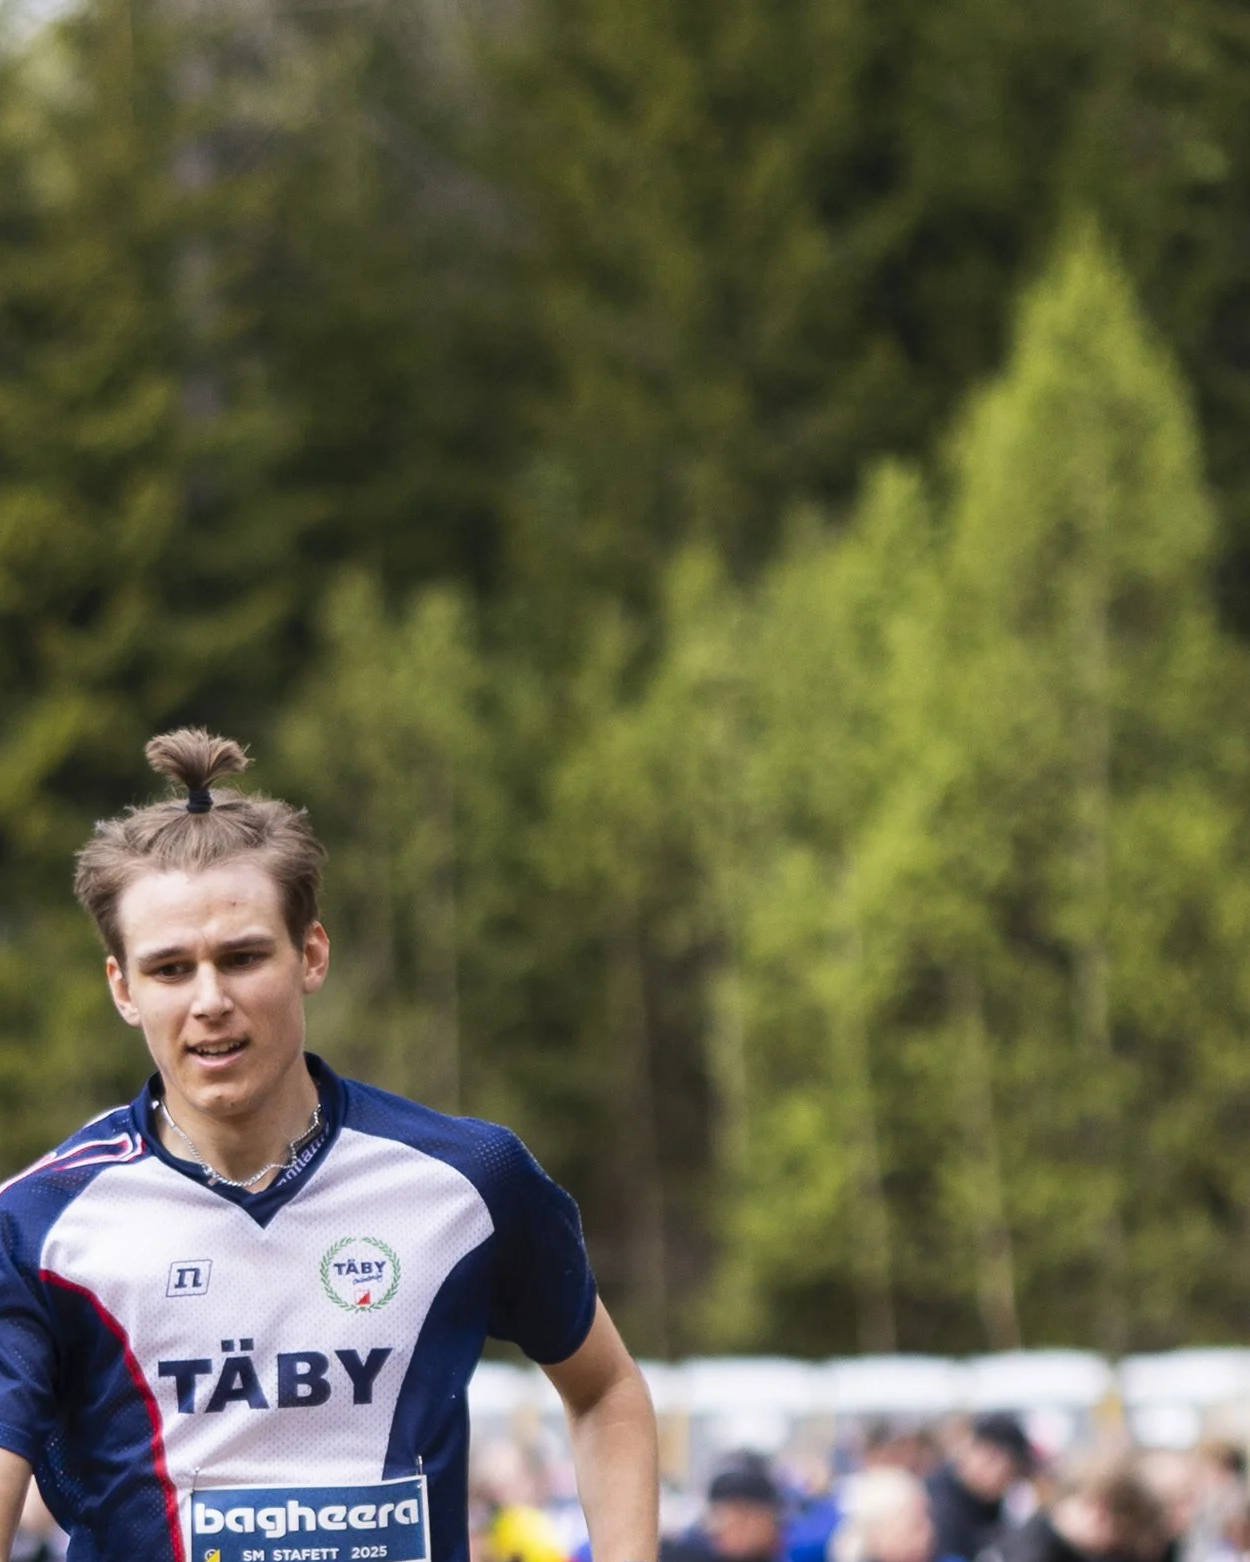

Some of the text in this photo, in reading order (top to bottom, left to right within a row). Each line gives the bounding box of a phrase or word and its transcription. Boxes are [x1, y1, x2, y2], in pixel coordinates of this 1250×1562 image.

[333, 1258, 387, 1276] TÄBY
[157, 1337, 394, 1415] TÄBY
[194, 1498, 419, 1539] bagheera
[242, 1545, 388, 1562] SM STAFETT 2025
